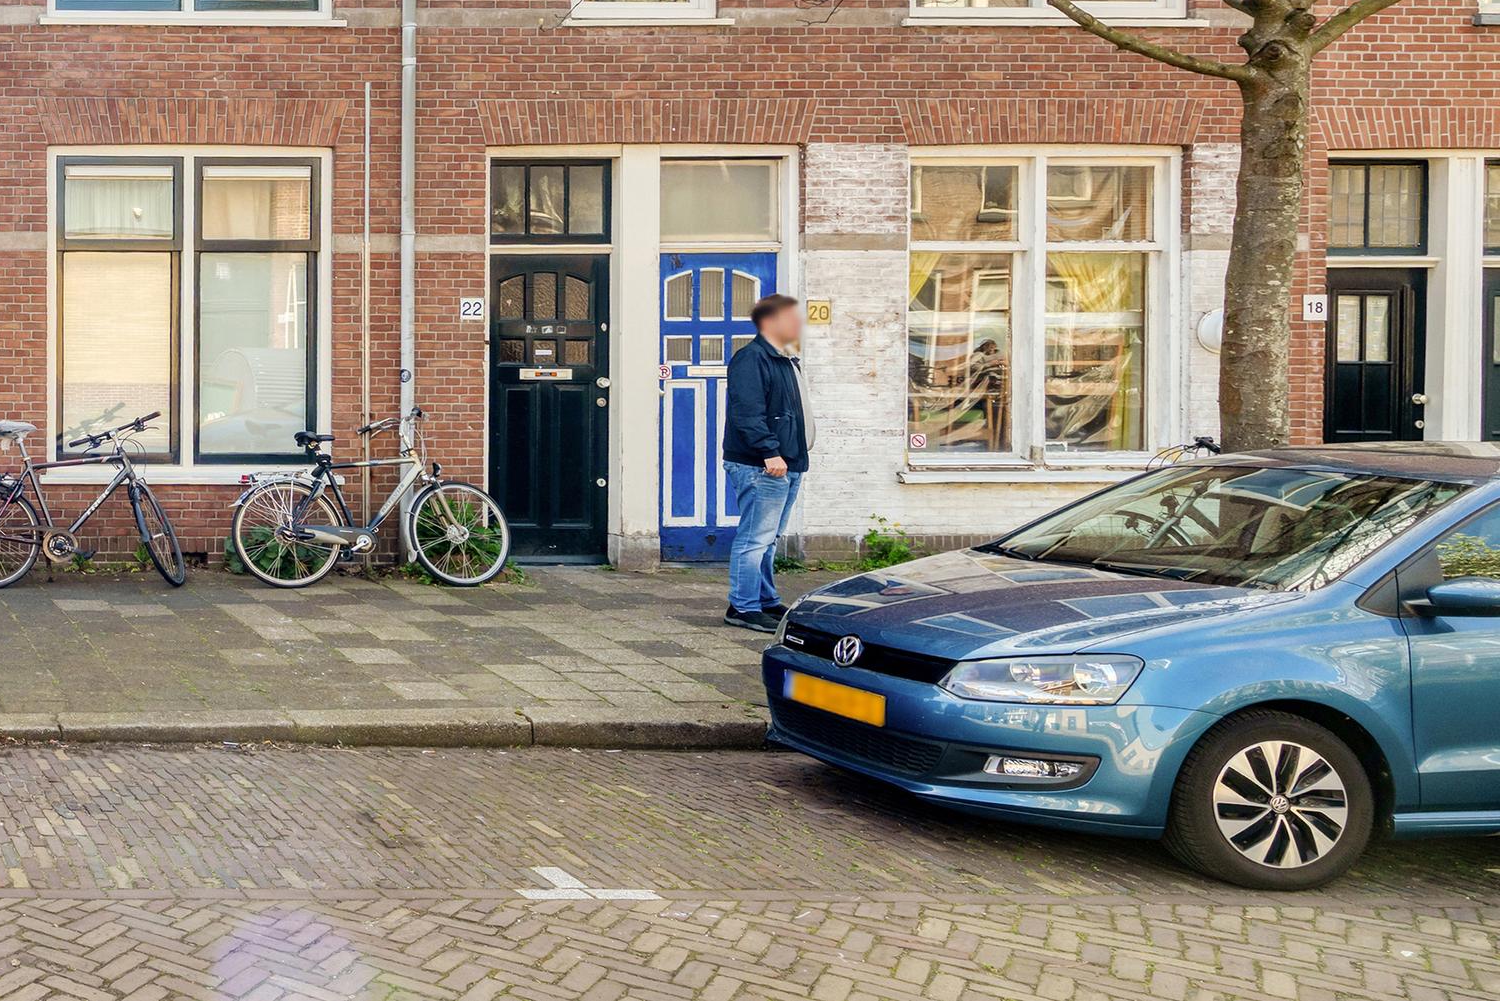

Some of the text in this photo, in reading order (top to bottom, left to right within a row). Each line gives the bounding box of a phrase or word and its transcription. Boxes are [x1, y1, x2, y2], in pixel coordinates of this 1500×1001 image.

[462, 301, 482, 316] 22
[809, 305, 829, 320] 20
[1307, 301, 1323, 313] 18
